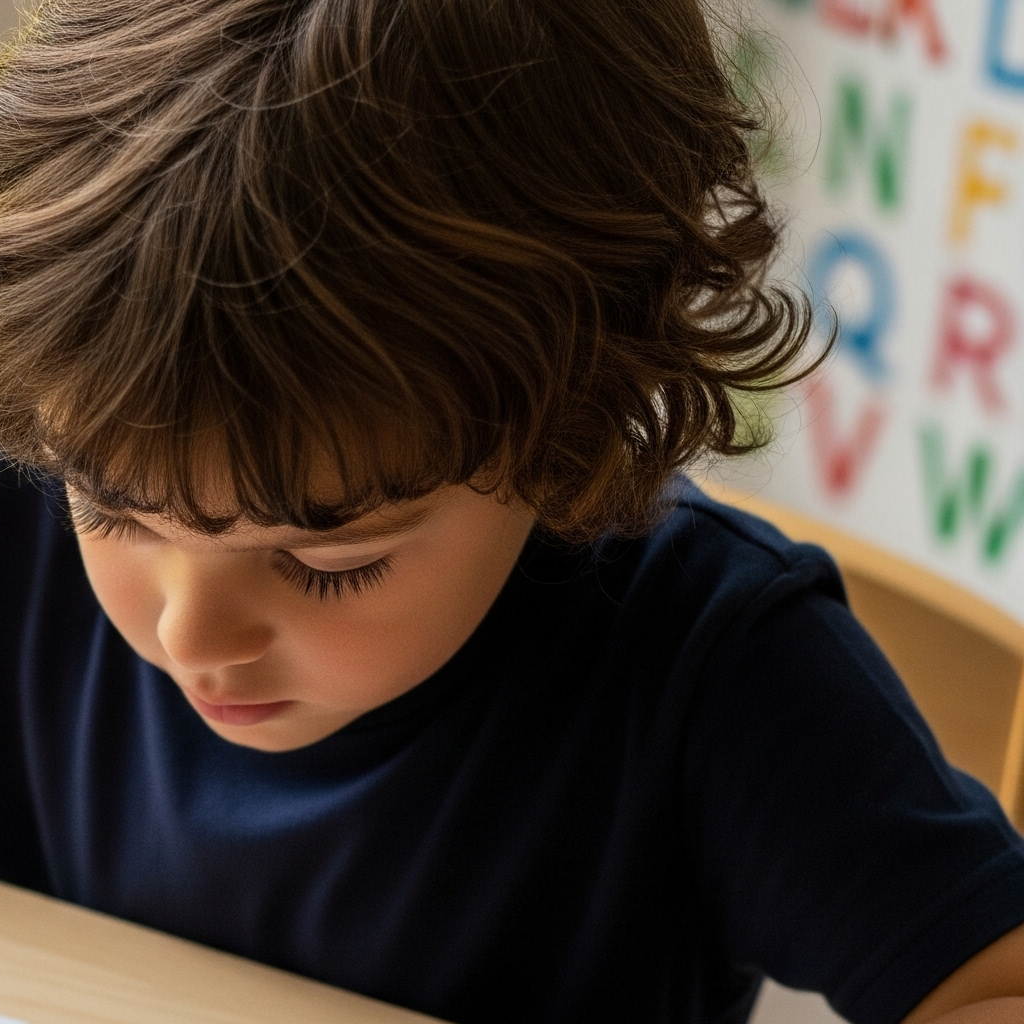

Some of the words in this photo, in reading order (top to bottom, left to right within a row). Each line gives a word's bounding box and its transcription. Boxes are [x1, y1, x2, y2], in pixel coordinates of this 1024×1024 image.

[947, 117, 1021, 246] F
[812, 230, 898, 382] Q
[929, 276, 1016, 414] R
[804, 376, 884, 496] V
